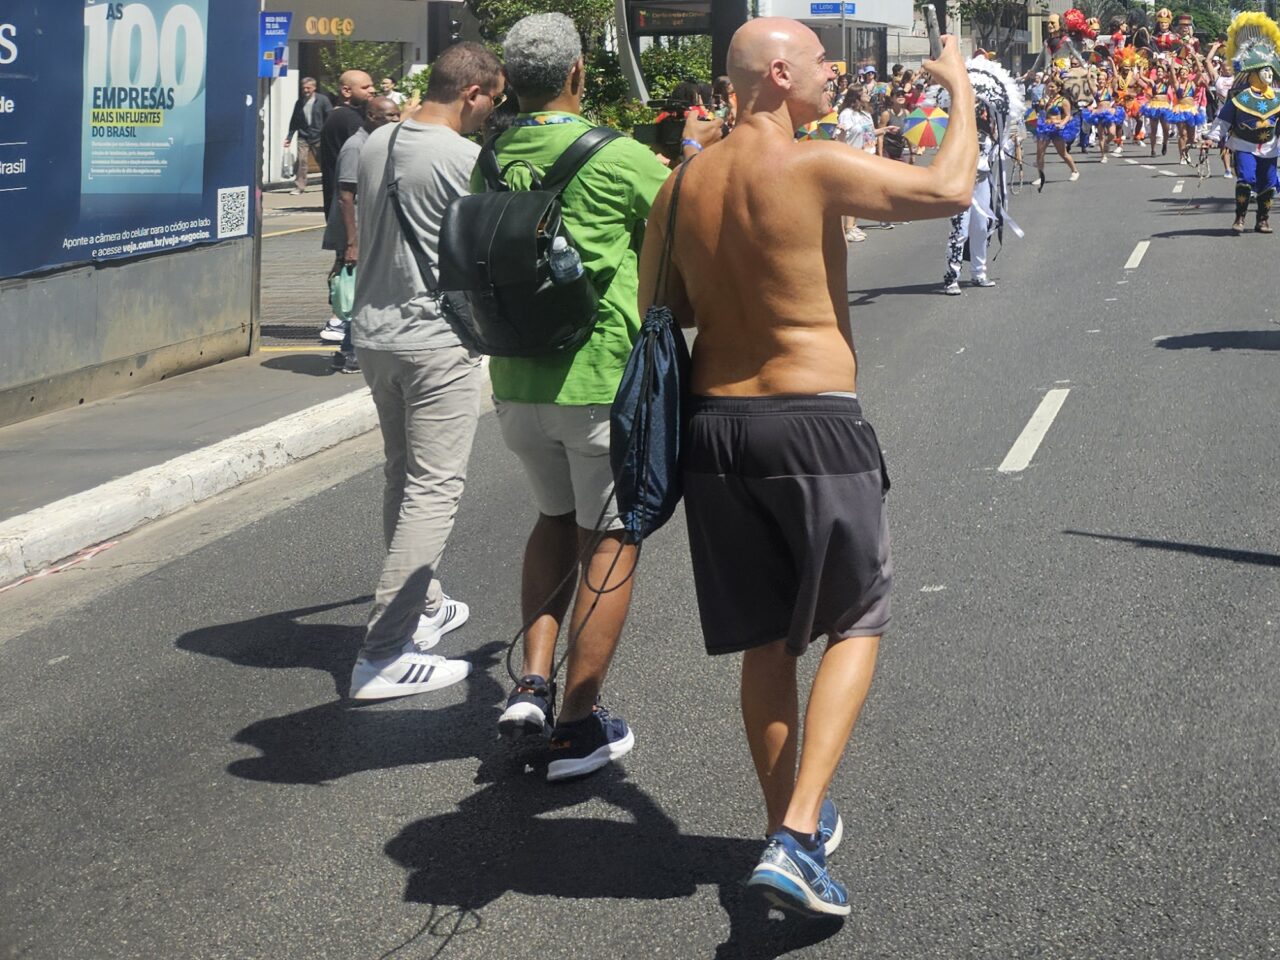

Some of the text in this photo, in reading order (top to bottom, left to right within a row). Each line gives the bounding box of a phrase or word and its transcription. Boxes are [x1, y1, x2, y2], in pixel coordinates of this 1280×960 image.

[106, 3, 124, 20] AS
[84, 2, 207, 108] 100
[92, 87, 175, 110] EMPRESAS
[92, 111, 161, 124] MAIS INFLUENTES
[92, 125, 137, 138] DO BRASIL
[0, 158, 26, 175] rasil
[63, 237, 89, 250] Aponte
[95, 232, 121, 243] câmera
[122, 230, 130, 239] do
[92, 249, 98, 257] e
[98, 246, 122, 256] acesse
